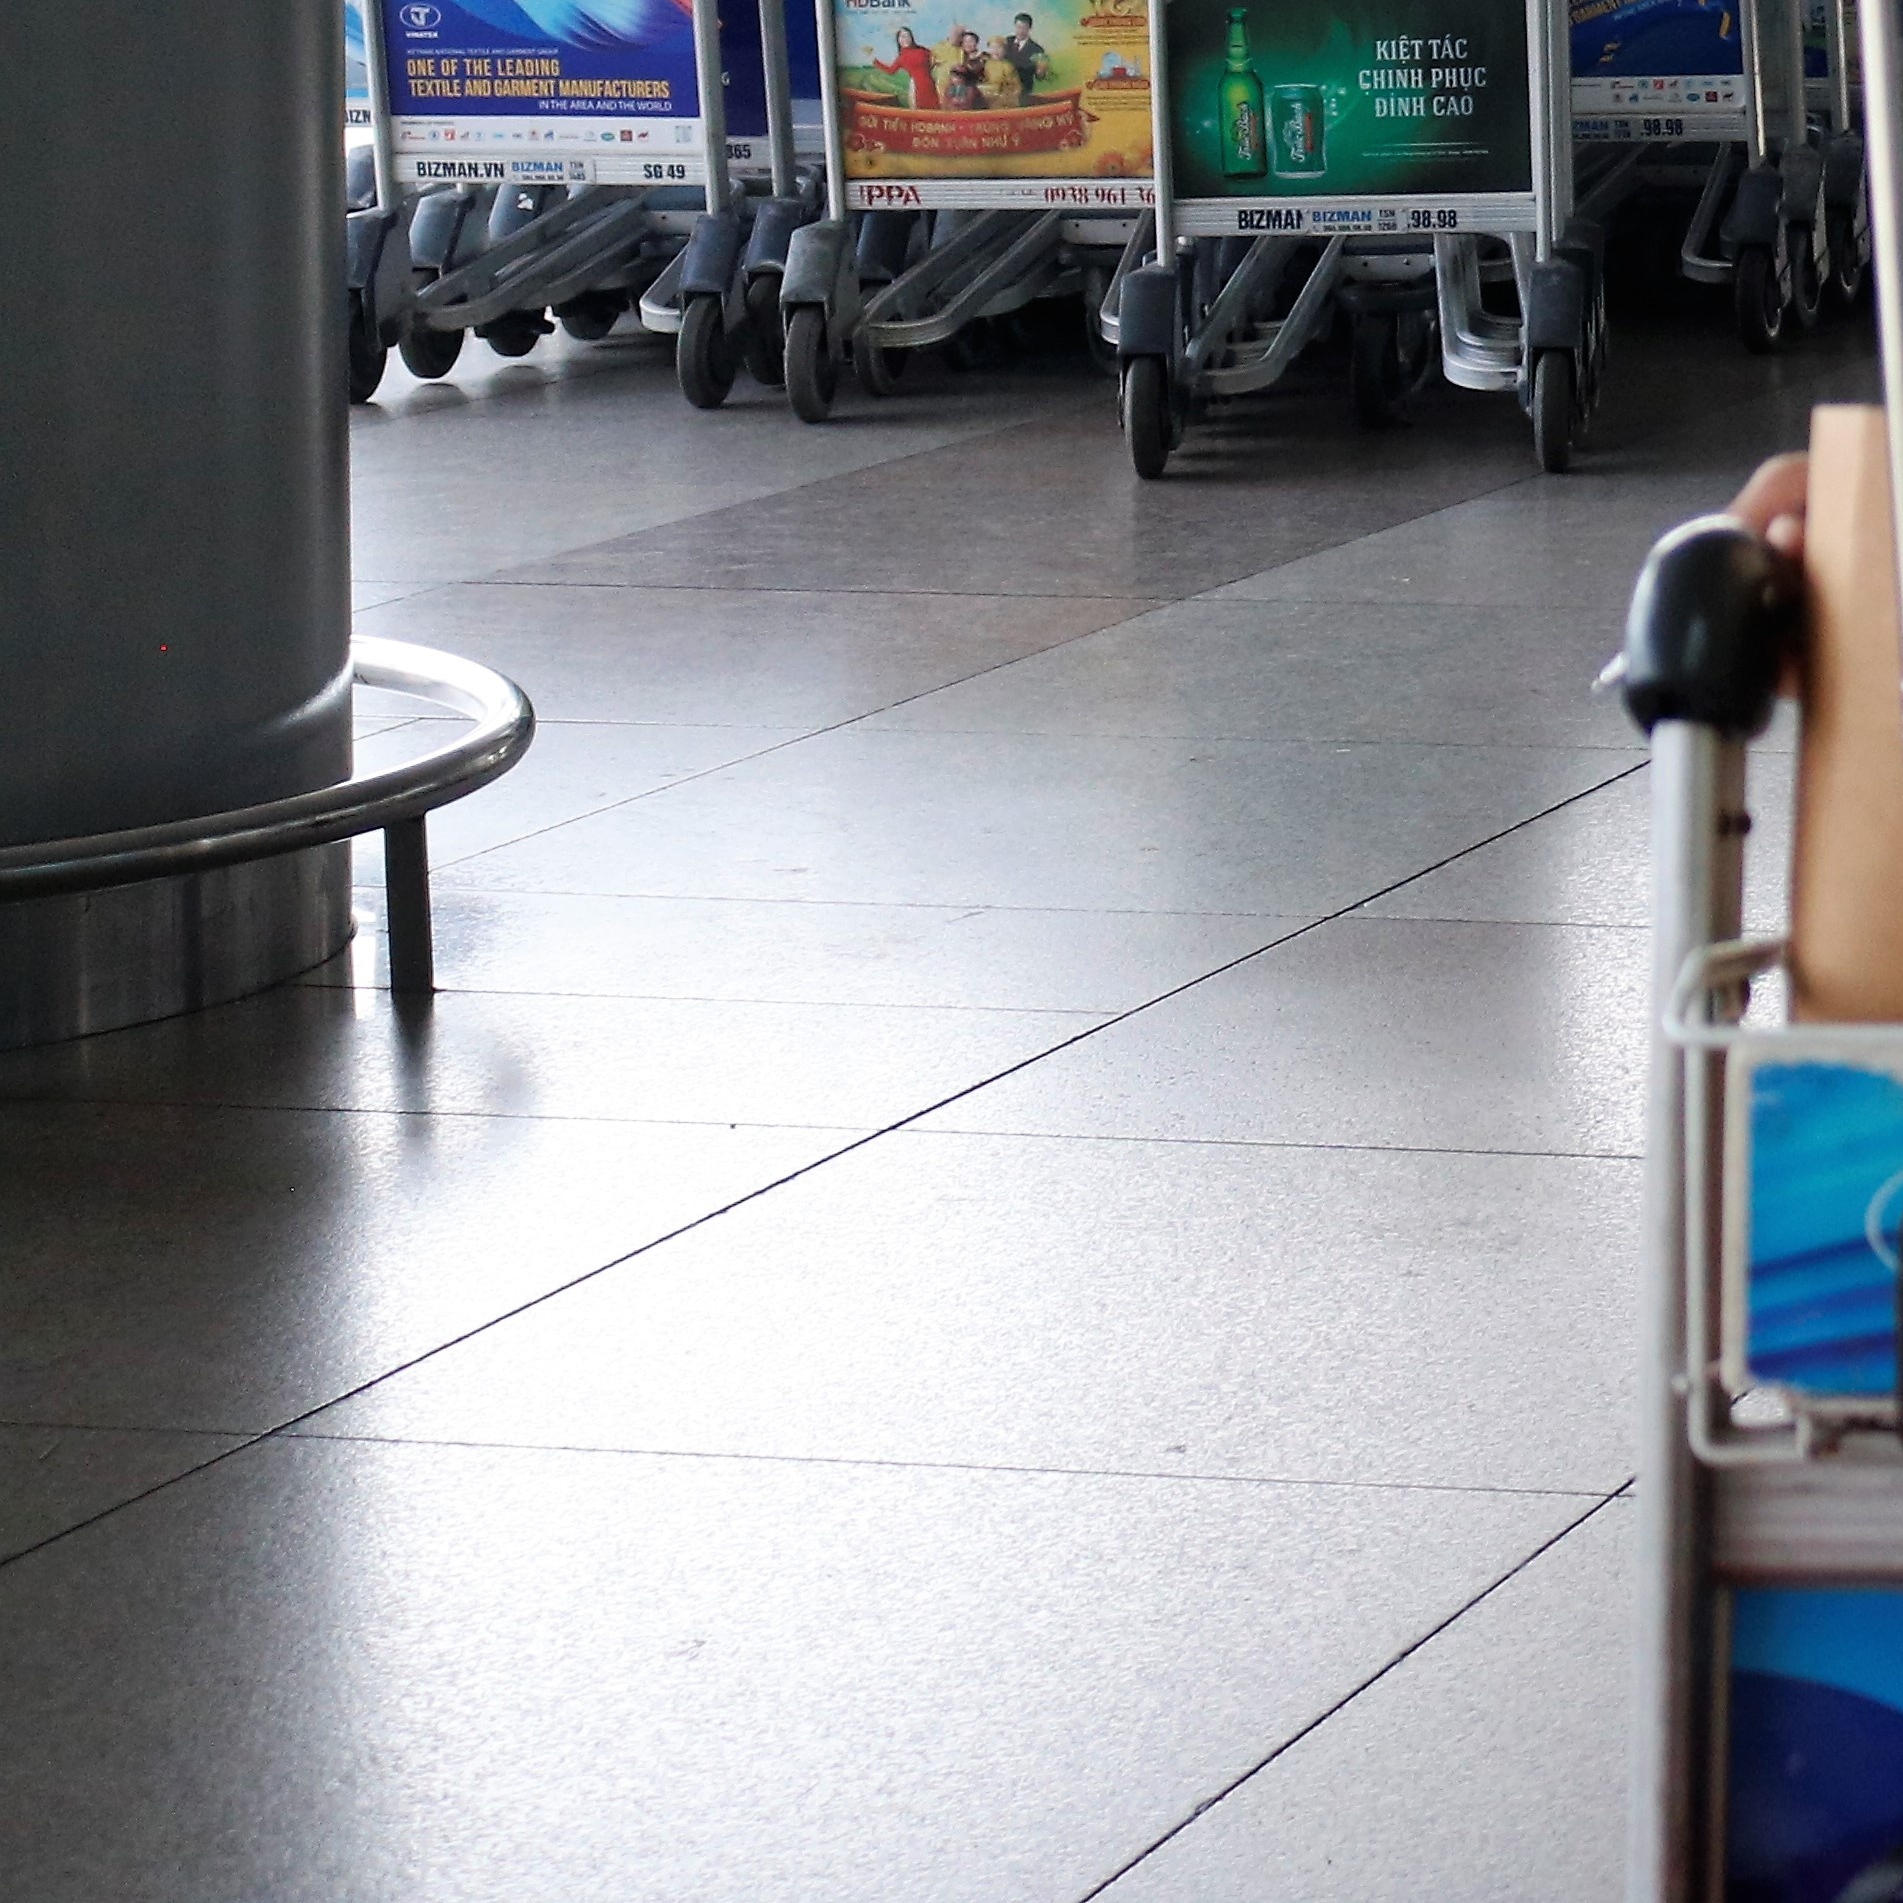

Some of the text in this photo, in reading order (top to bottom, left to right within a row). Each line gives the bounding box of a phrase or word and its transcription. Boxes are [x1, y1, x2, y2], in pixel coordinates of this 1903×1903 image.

[1375, 33, 1469, 65] KIỆT TÁC
[406, 58, 560, 77] ONE OF THE LEADING
[408, 78, 671, 98] TEXTILE AND GARMENT MANUFACTURERS
[1431, 66, 1488, 92] PHỤC
[538, 99, 549, 110] IN
[550, 99, 568, 111] THE
[637, 100, 673, 112] WORLD
[1433, 96, 1475, 117] CAO
[416, 161, 504, 178] BIZMAN.VN
[512, 161, 563, 172] BIZMAN
[643, 164, 662, 179] SG
[667, 164, 685, 179] 49
[1312, 210, 1372, 222] BIZMAN
